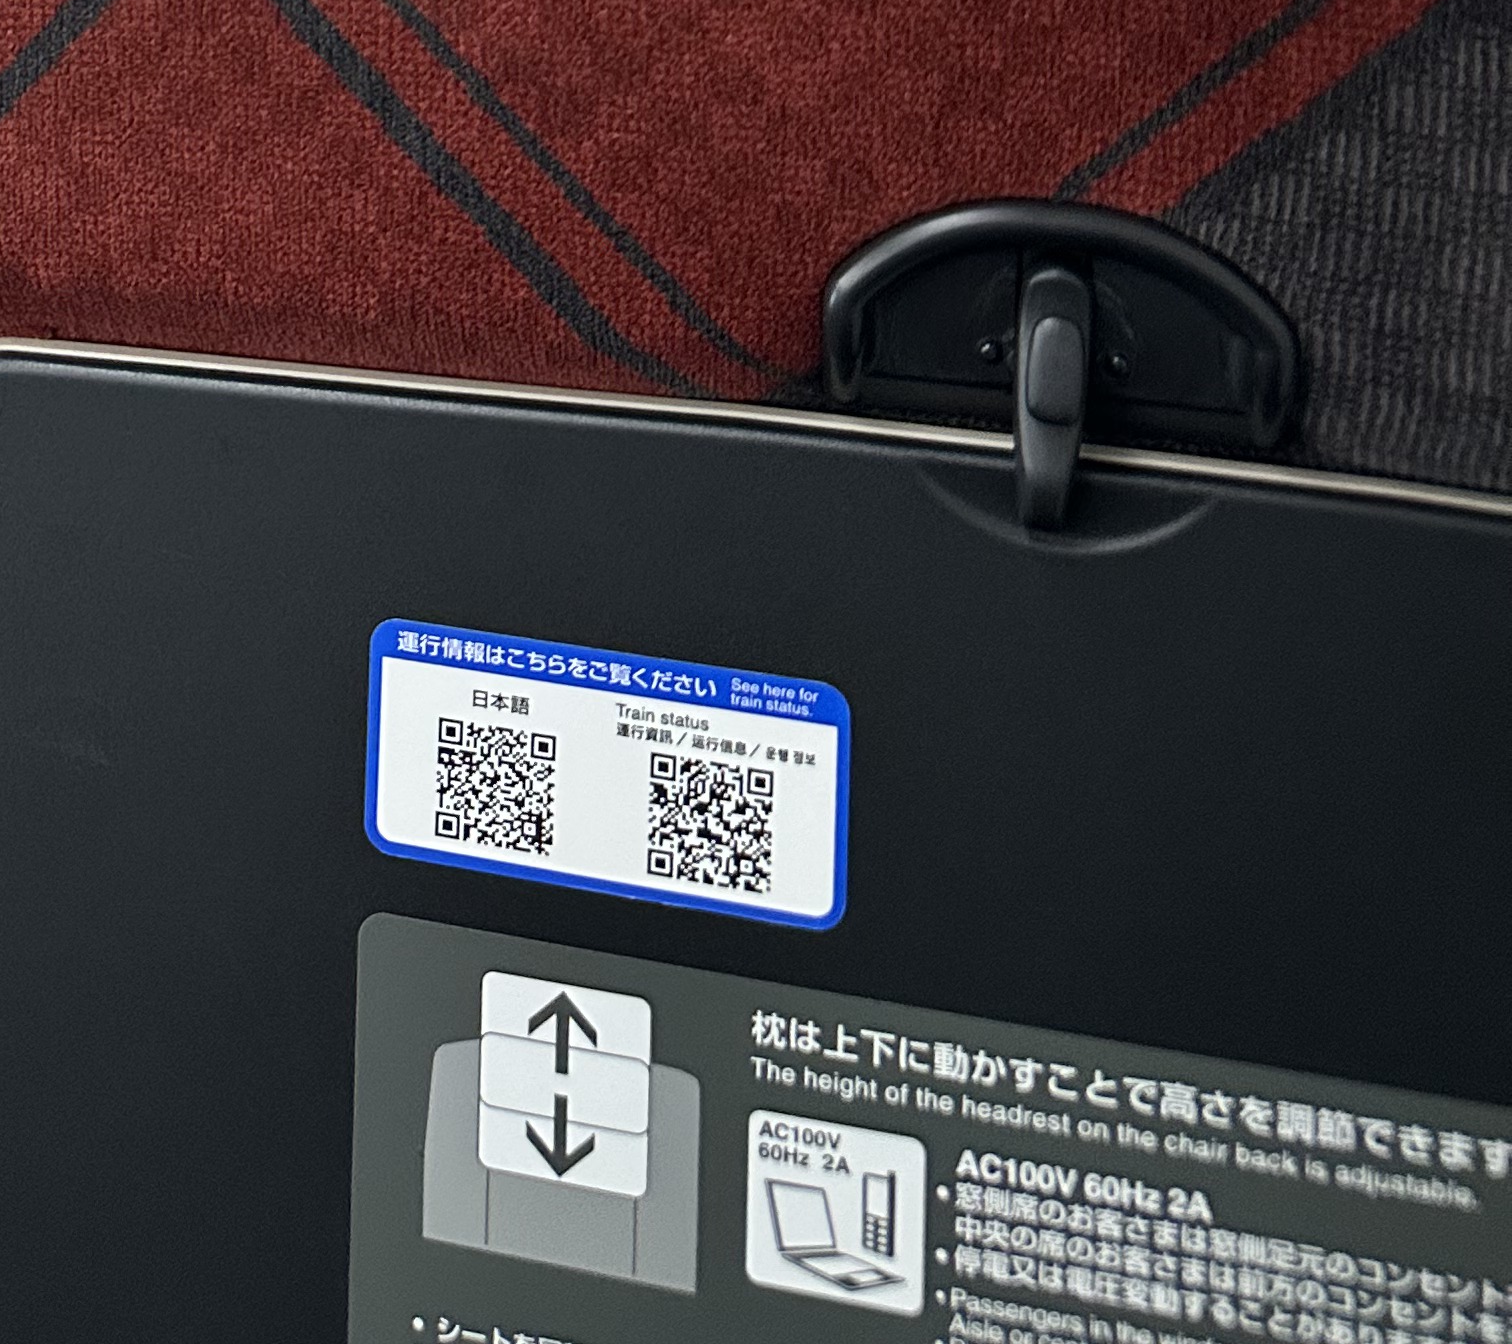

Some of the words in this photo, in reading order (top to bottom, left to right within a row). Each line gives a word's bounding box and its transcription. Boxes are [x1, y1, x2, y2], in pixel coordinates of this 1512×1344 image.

[397, 630, 718, 698] 運行情報はこちらをご覧ください
[472, 689, 530, 717] 日本語
[730, 693, 760, 710] train
[765, 698, 813, 718] status.
[731, 677, 761, 696] See
[764, 682, 796, 700] here
[798, 686, 819, 703] for
[616, 703, 656, 724] Train
[661, 710, 709, 731] status
[750, 1055, 796, 1086] The
[804, 1065, 877, 1102] height
[884, 1083, 909, 1105] of
[915, 1087, 954, 1116] the
[961, 1094, 1071, 1137] headrest
[1077, 1119, 1110, 1143] on
[1117, 1122, 1158, 1152] the
[1164, 1132, 1228, 1163] chair
[1235, 1141, 1298, 1177] back
[758, 1120, 841, 1151] AC100V
[758, 1142, 809, 1169] 60Hz
[822, 1153, 851, 1175] 2A
[955, 1149, 1078, 1198] AC100V
[1083, 1172, 1162, 1215] 60Hz
[1167, 1187, 1213, 1224] 2A
[955, 1182, 1512, 1308] 窓側席のお客さまは窓側足元のコンセント
